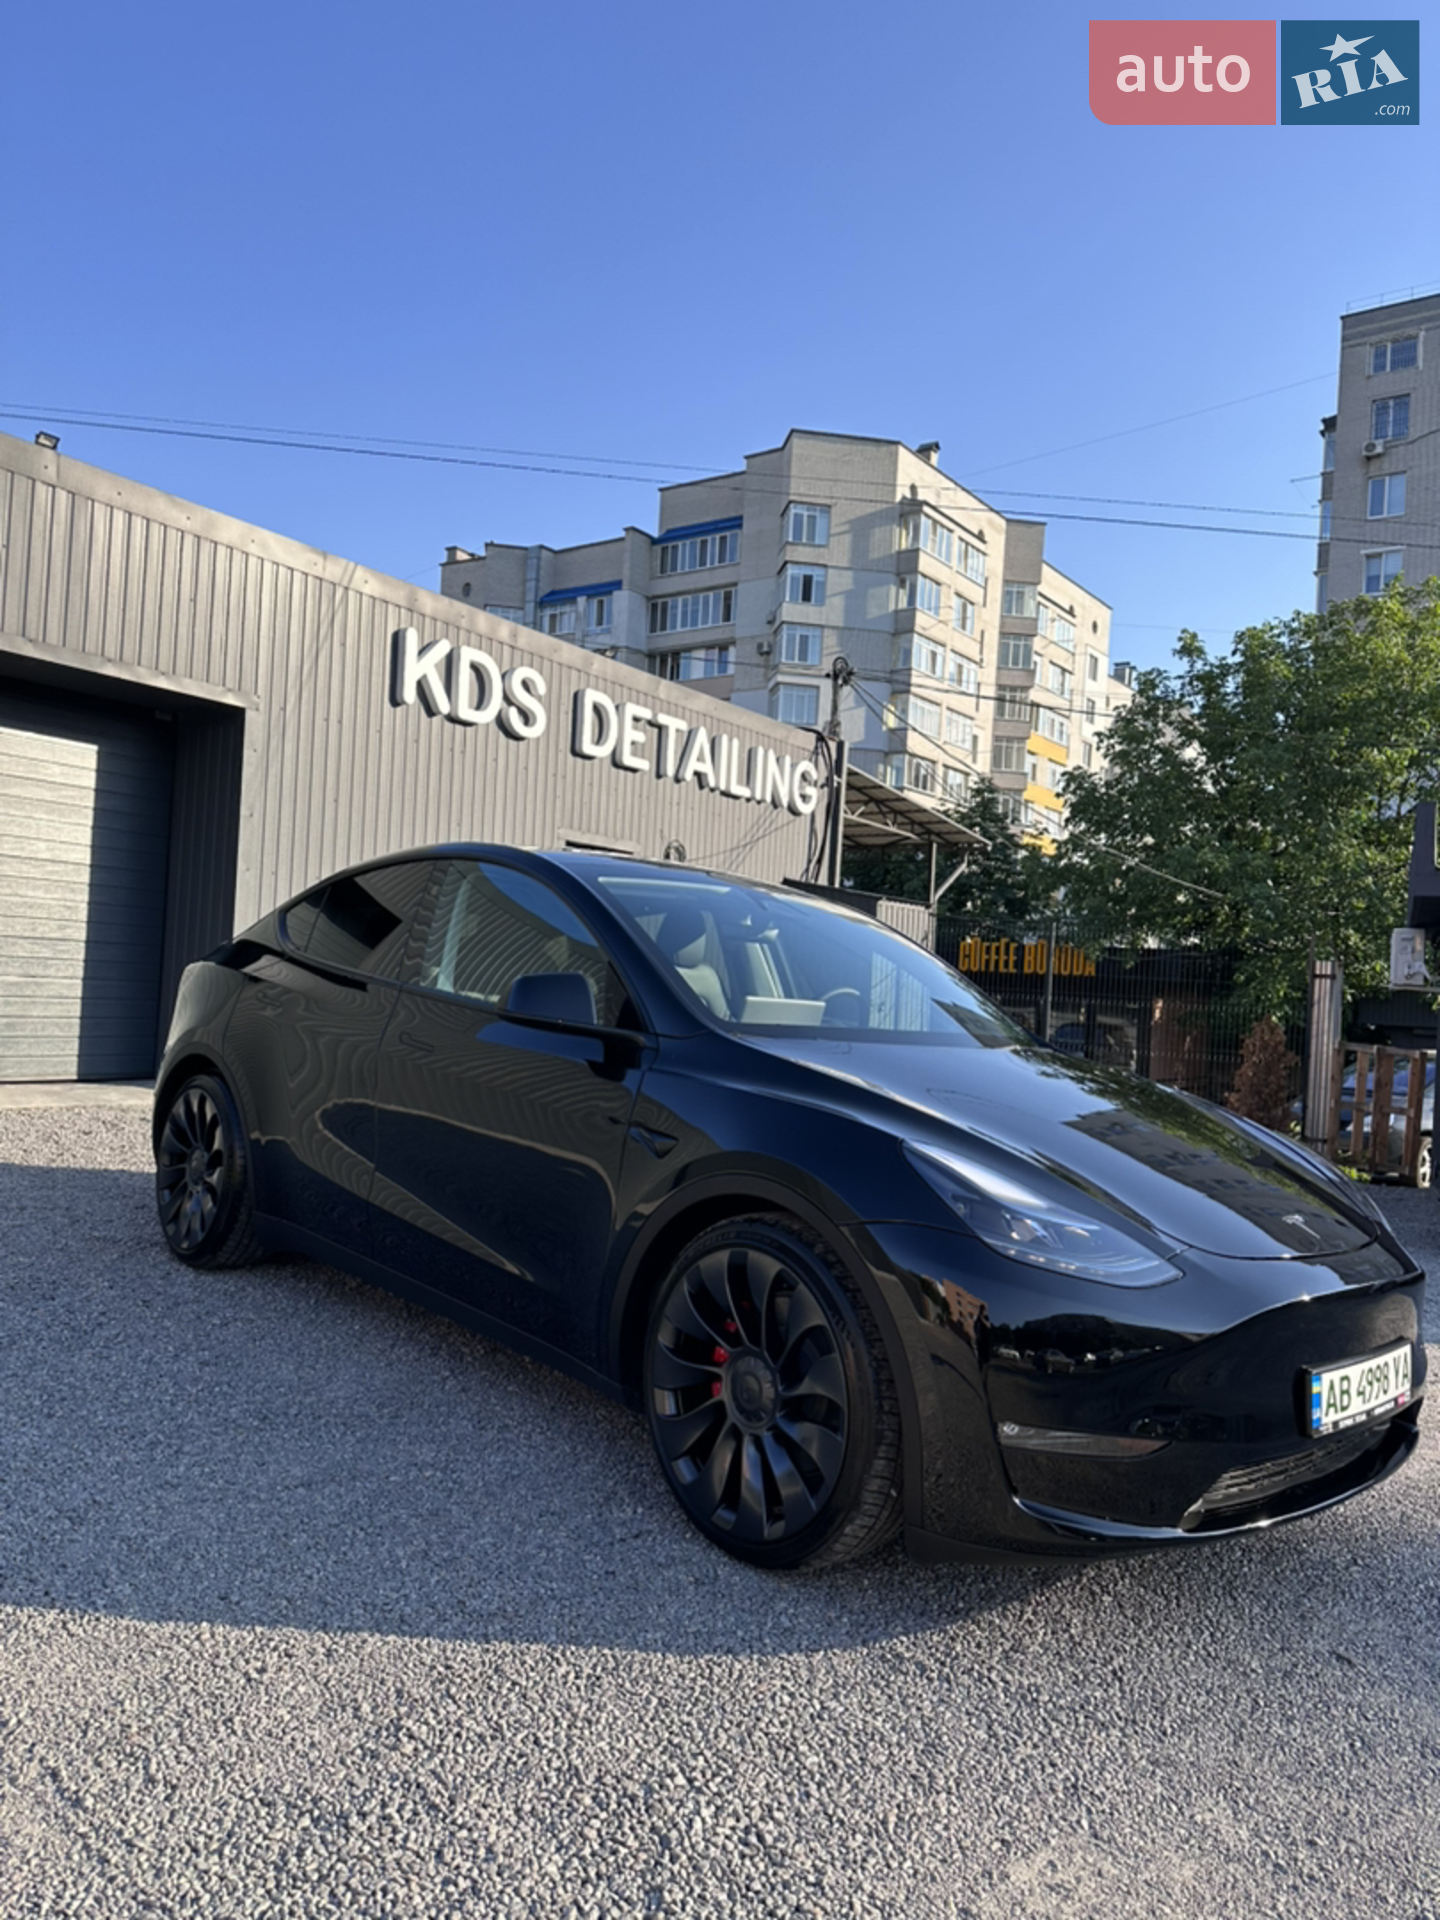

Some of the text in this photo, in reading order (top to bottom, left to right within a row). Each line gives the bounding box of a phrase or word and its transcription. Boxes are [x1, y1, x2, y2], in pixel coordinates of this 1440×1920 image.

[394, 627, 819, 816] KDS DETAILING
[958, 936, 1018, 973] COFFEE
[1325, 1375, 1352, 1417] AB
[1356, 1361, 1390, 1405] 4998
[1393, 1352, 1409, 1390] YA
